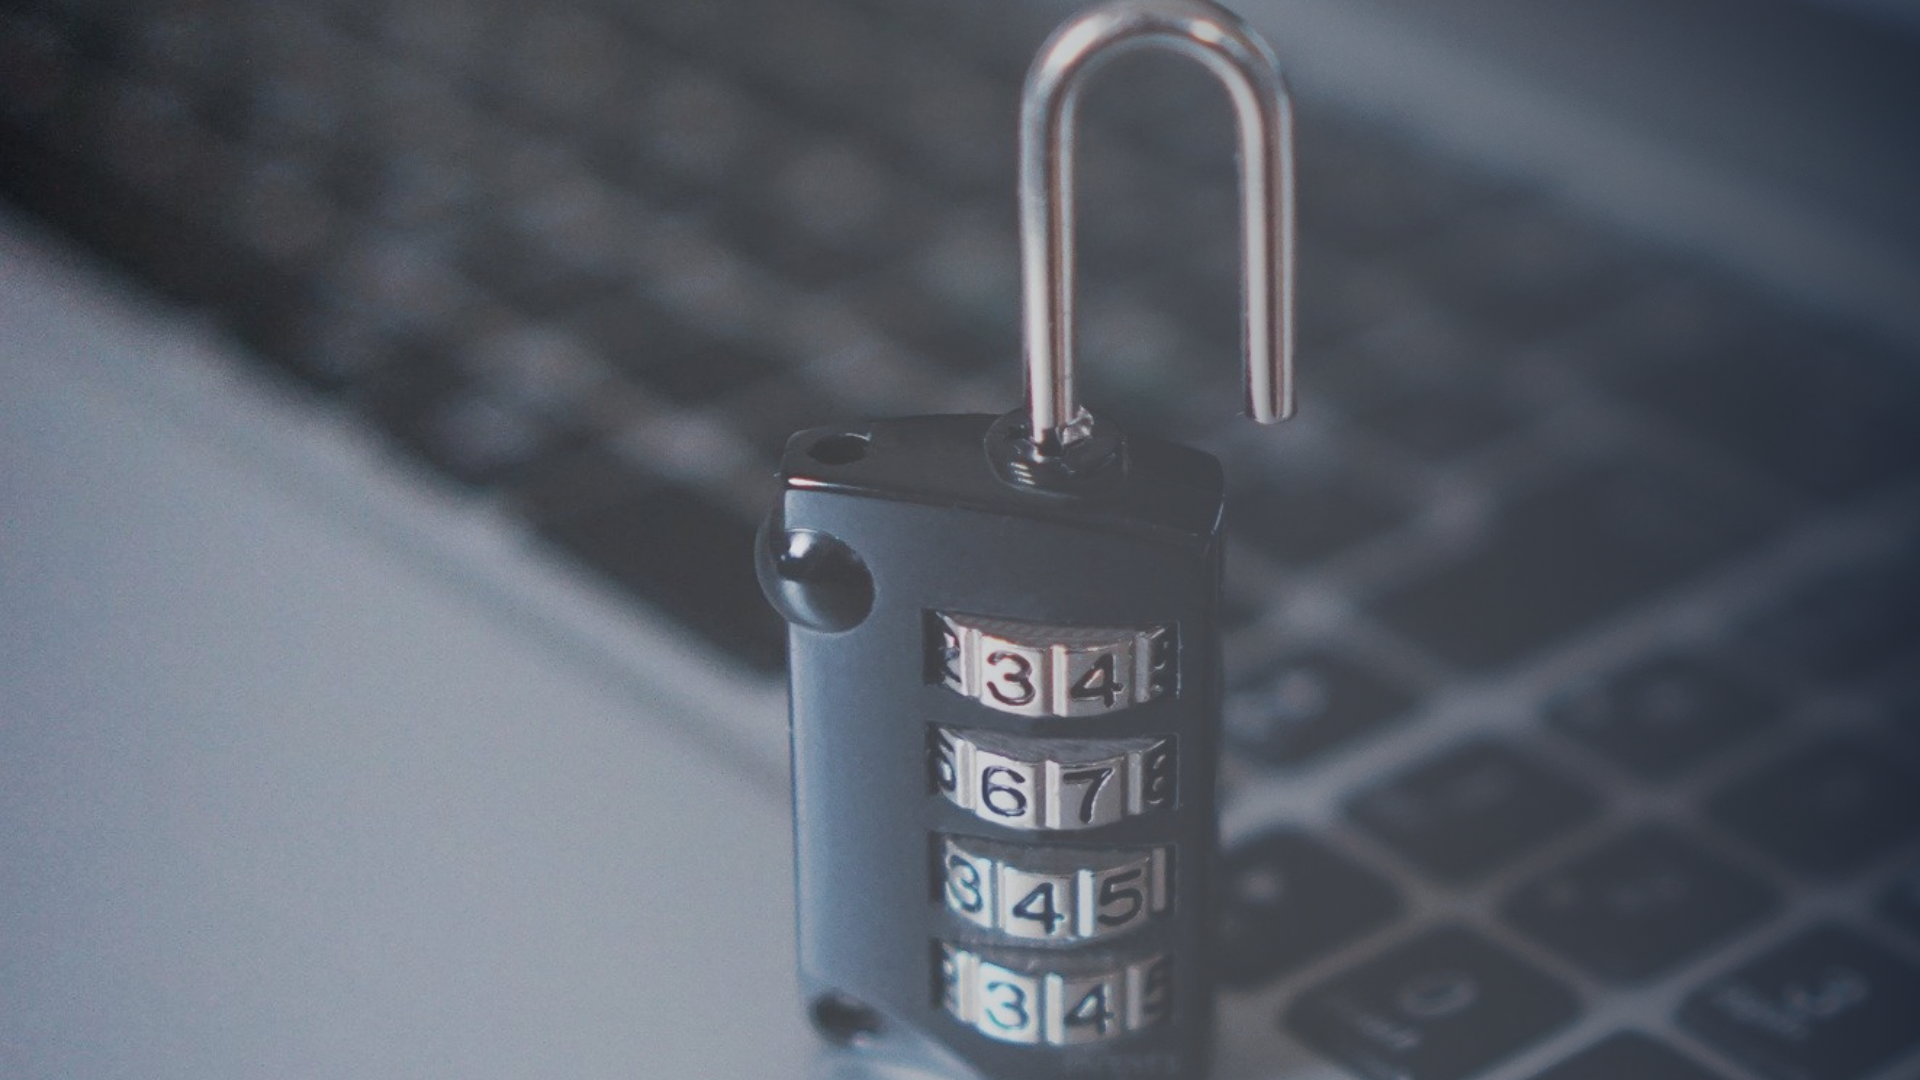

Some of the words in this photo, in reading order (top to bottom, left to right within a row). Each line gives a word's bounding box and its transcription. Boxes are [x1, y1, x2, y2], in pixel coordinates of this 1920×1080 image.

[987, 650, 1036, 706] 3
[1070, 652, 1123, 708] 4
[981, 766, 1027, 818] 6
[1063, 766, 1115, 824] 7
[949, 854, 983, 913] 3
[1012, 882, 1064, 935] 4
[1098, 868, 1143, 927] 5
[986, 980, 1030, 1030] 3
[1064, 984, 1115, 1034] 4
